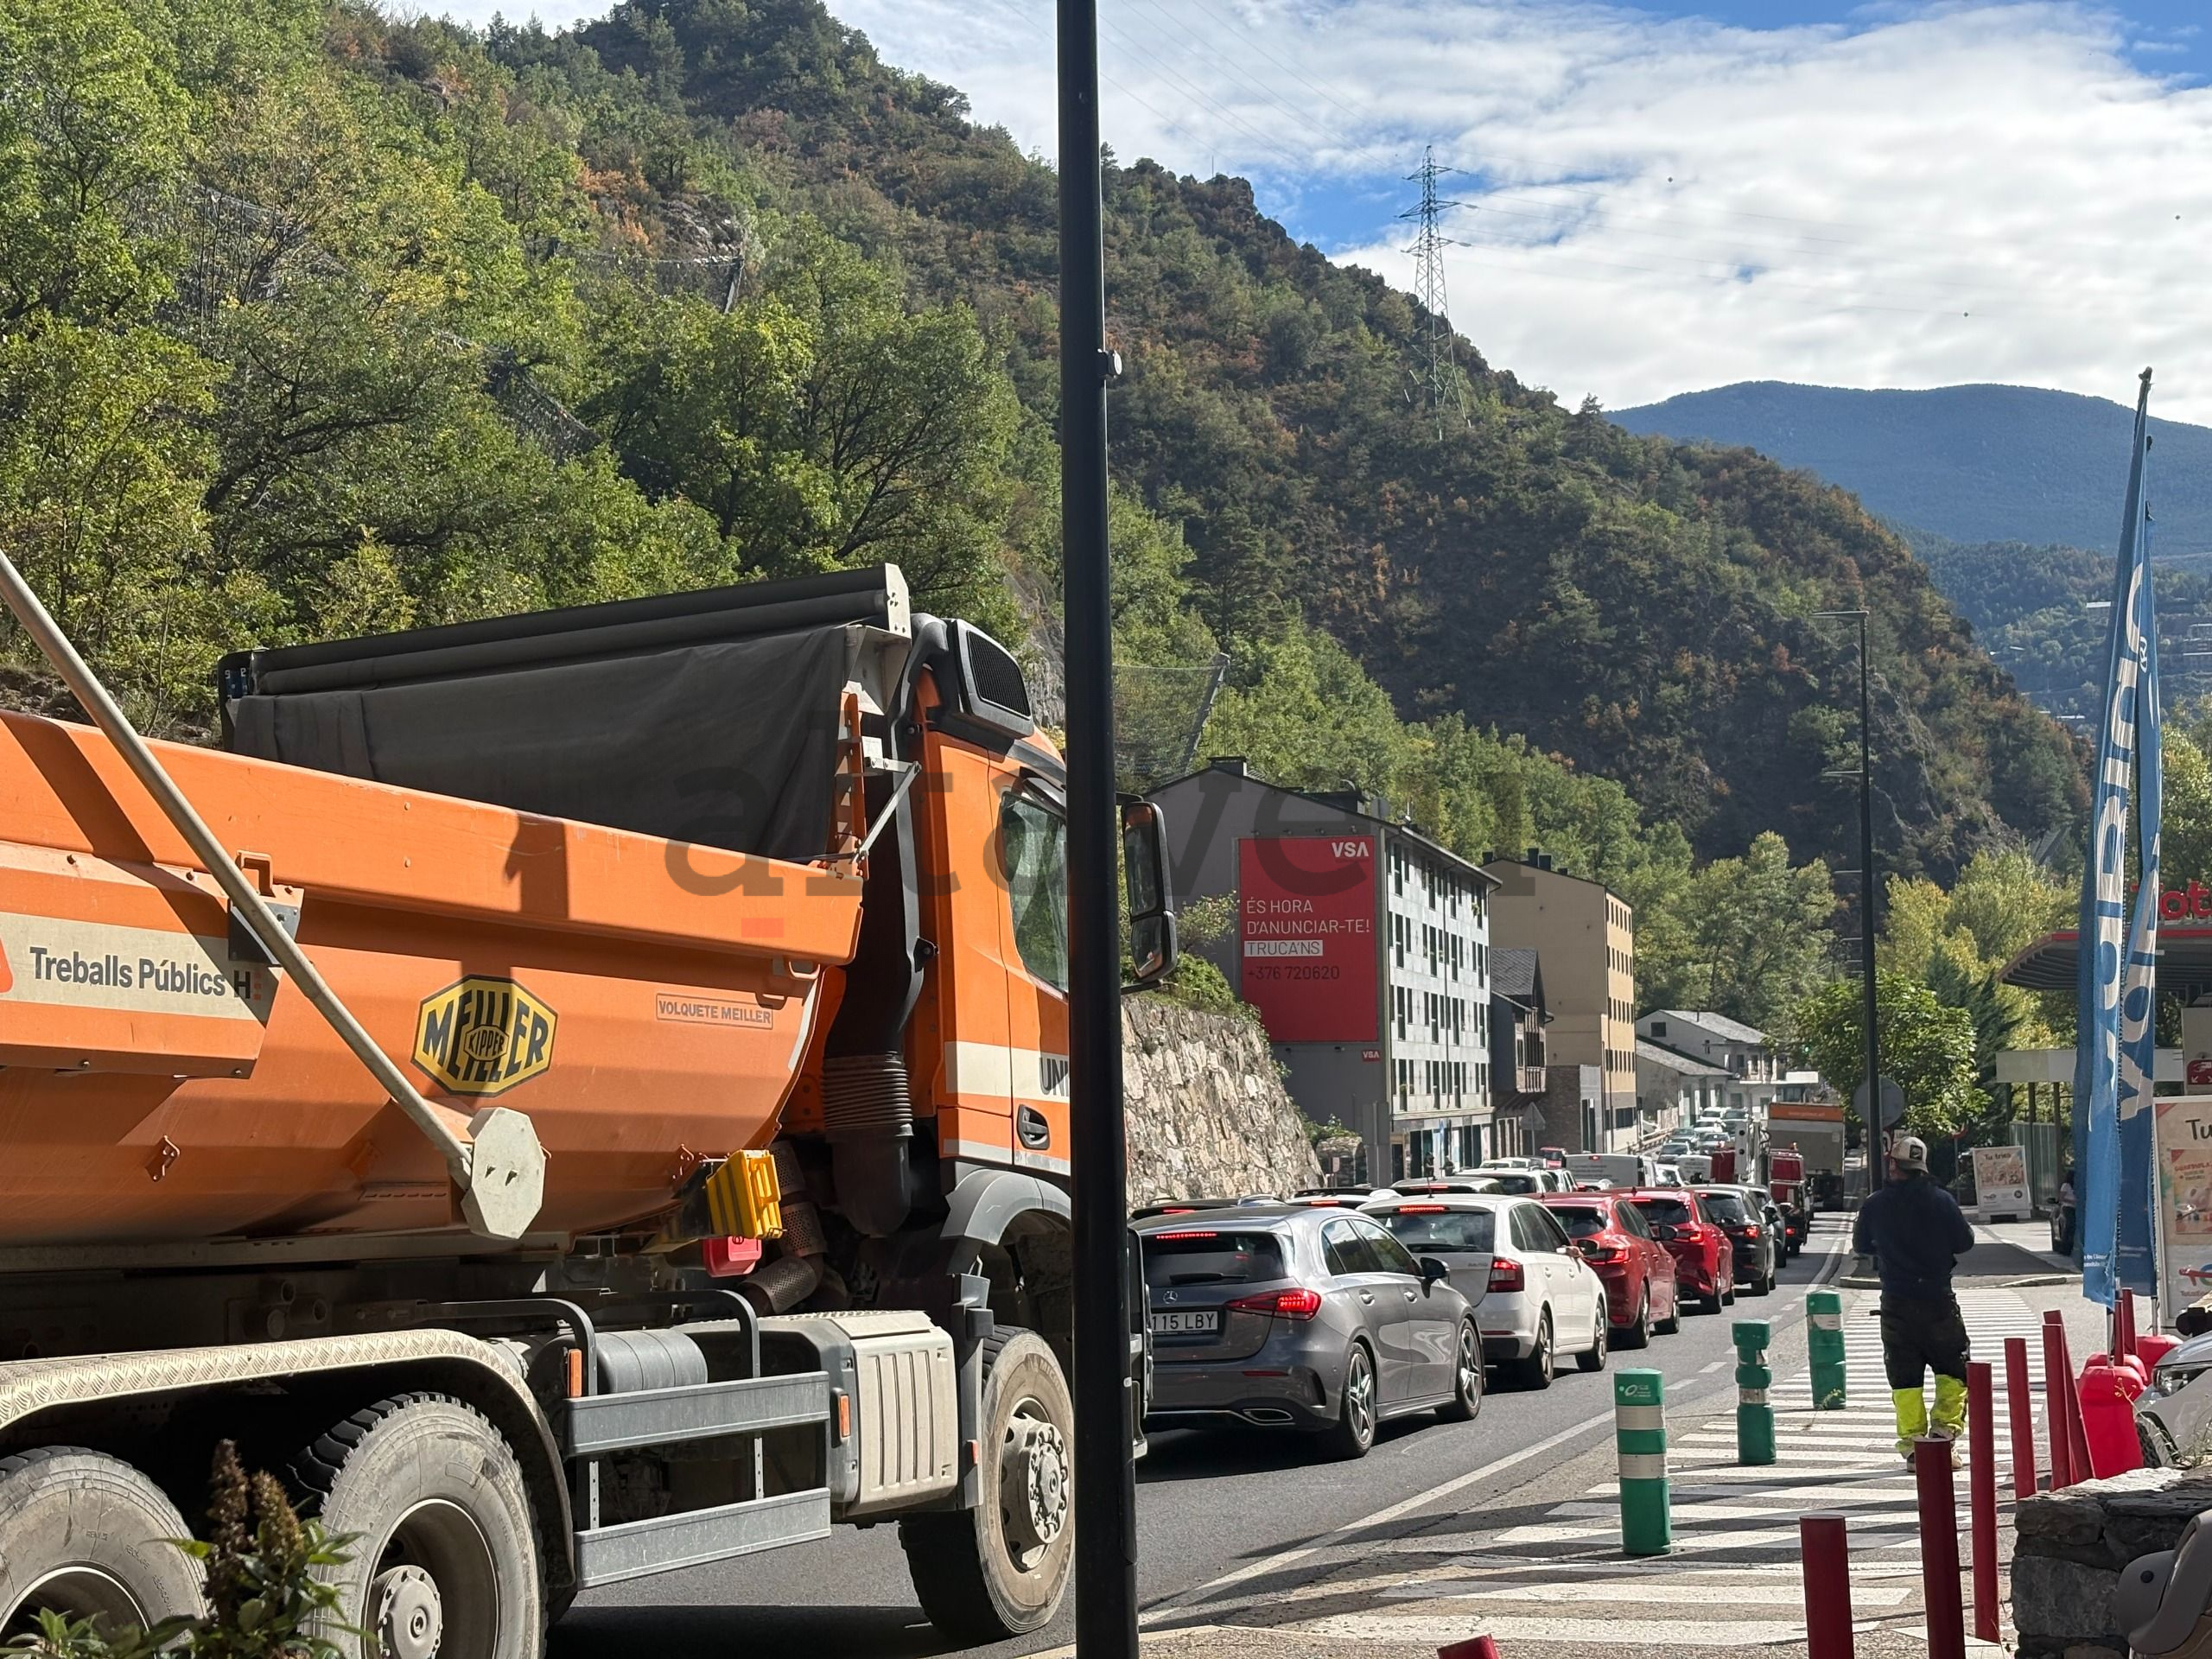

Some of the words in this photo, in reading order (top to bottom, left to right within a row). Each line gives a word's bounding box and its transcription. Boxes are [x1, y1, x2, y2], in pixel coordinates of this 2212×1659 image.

[1332, 842, 1370, 857] VSA
[1246, 897, 1266, 913] ÉS
[1270, 899, 1313, 913] HORA
[1246, 919, 1370, 935] D'ANUNCIAR-TE!
[29, 946, 133, 988] Treballs
[138, 958, 226, 996] Públics
[1248, 966, 1281, 980] +376
[1285, 966, 1340, 980] 720620
[658, 1001, 719, 1019] VOLQUETE
[721, 1007, 772, 1024] MEILLER
[423, 988, 550, 1083] MEILLER
[467, 1029, 505, 1058] KIPPER
[1362, 1050, 1380, 1058] VSA
[1185, 1313, 1214, 1329] LBY
